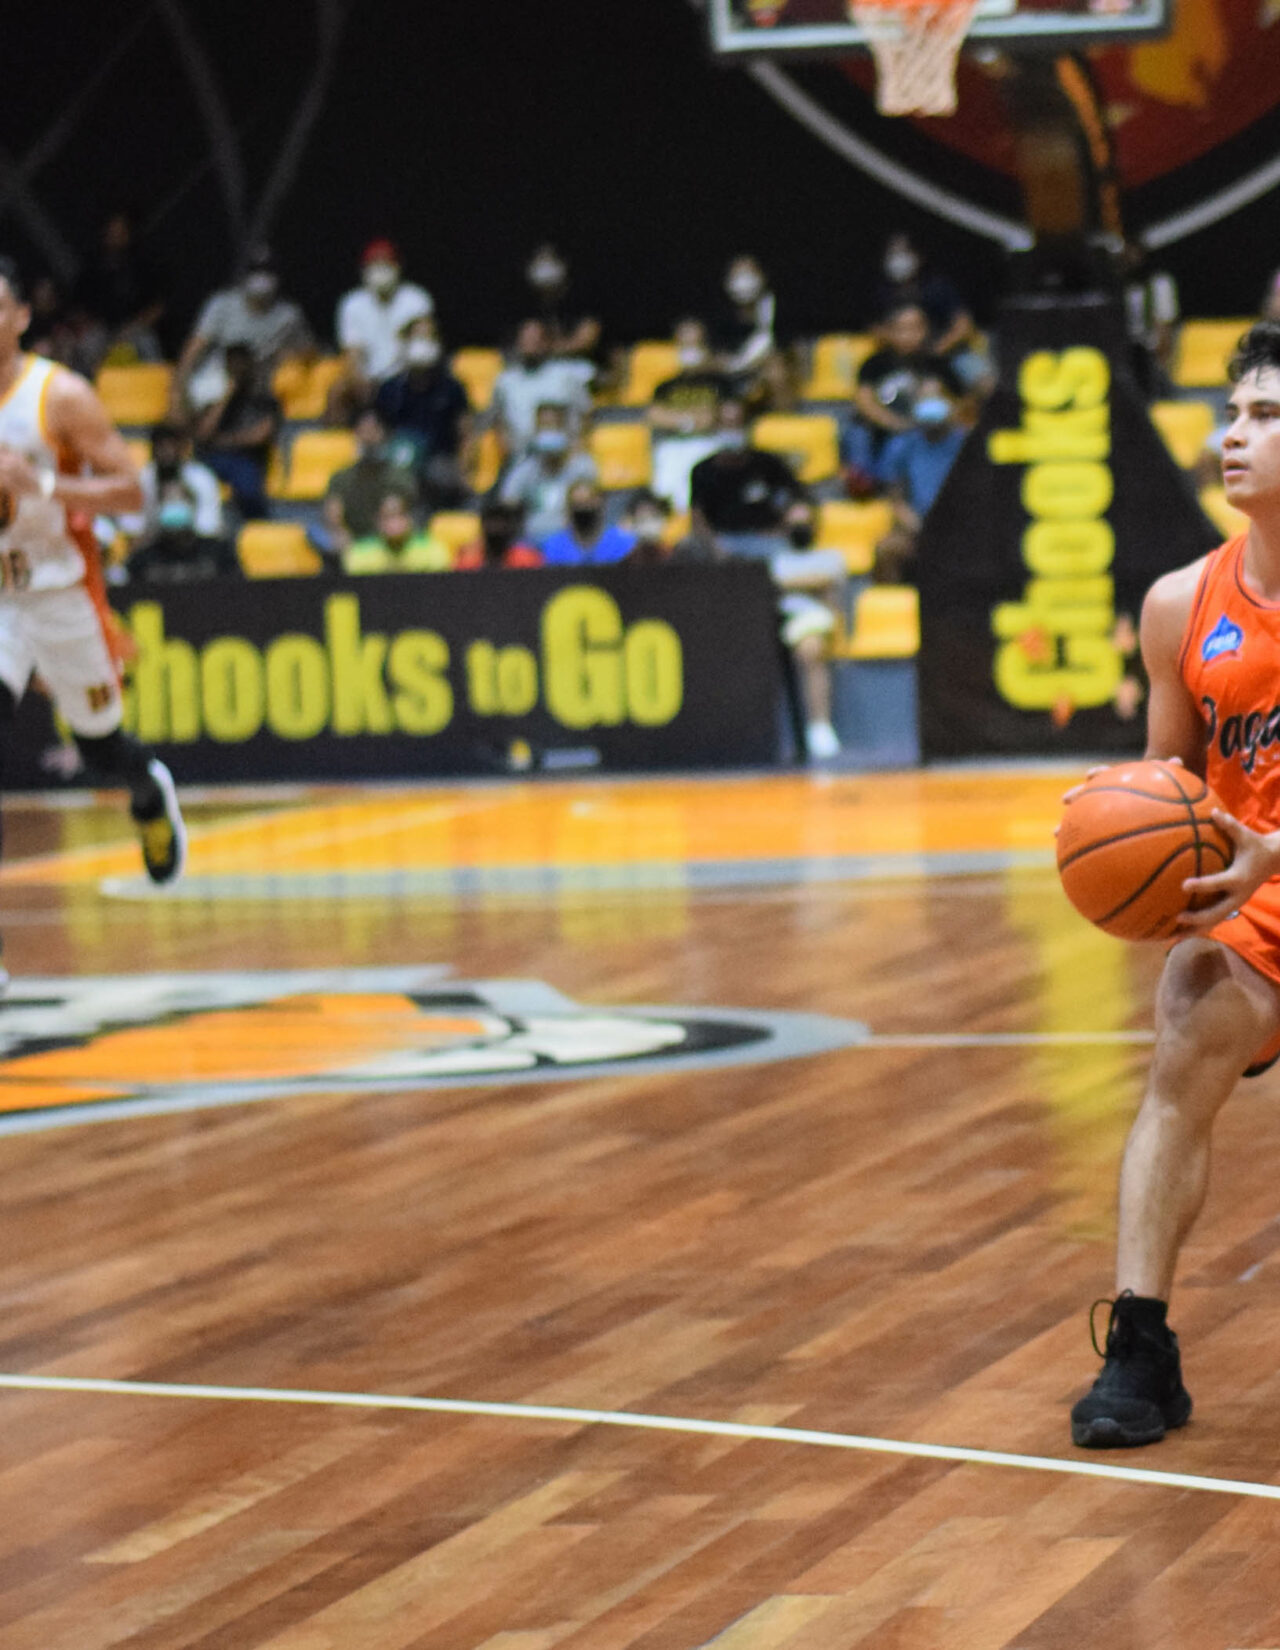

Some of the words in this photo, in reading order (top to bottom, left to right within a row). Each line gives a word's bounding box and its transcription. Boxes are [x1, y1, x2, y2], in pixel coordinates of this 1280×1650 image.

[988, 347, 1124, 711] Chooks
[119, 592, 455, 744] hooks
[466, 639, 539, 717] to
[541, 584, 684, 731] Go
